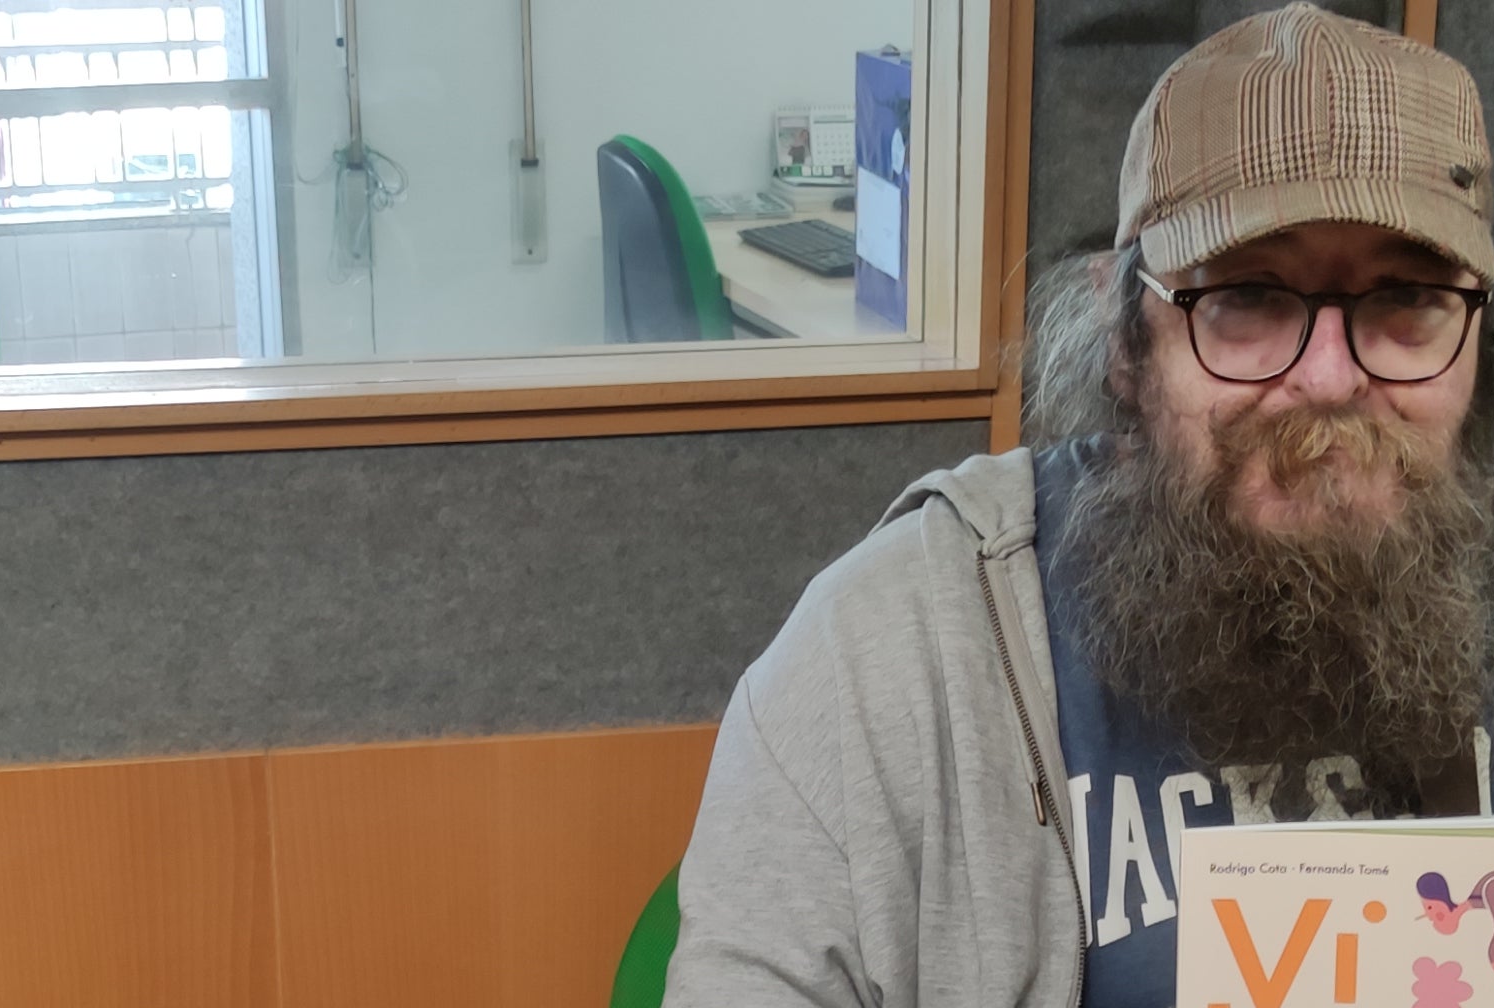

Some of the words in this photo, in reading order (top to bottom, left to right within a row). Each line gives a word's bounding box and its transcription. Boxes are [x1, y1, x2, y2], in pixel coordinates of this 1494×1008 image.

[1209, 862, 1256, 876] Rodrigo
[1259, 862, 1288, 875] Cota
[1298, 863, 1356, 876] Fernando
[1358, 864, 1390, 877] Tomé
